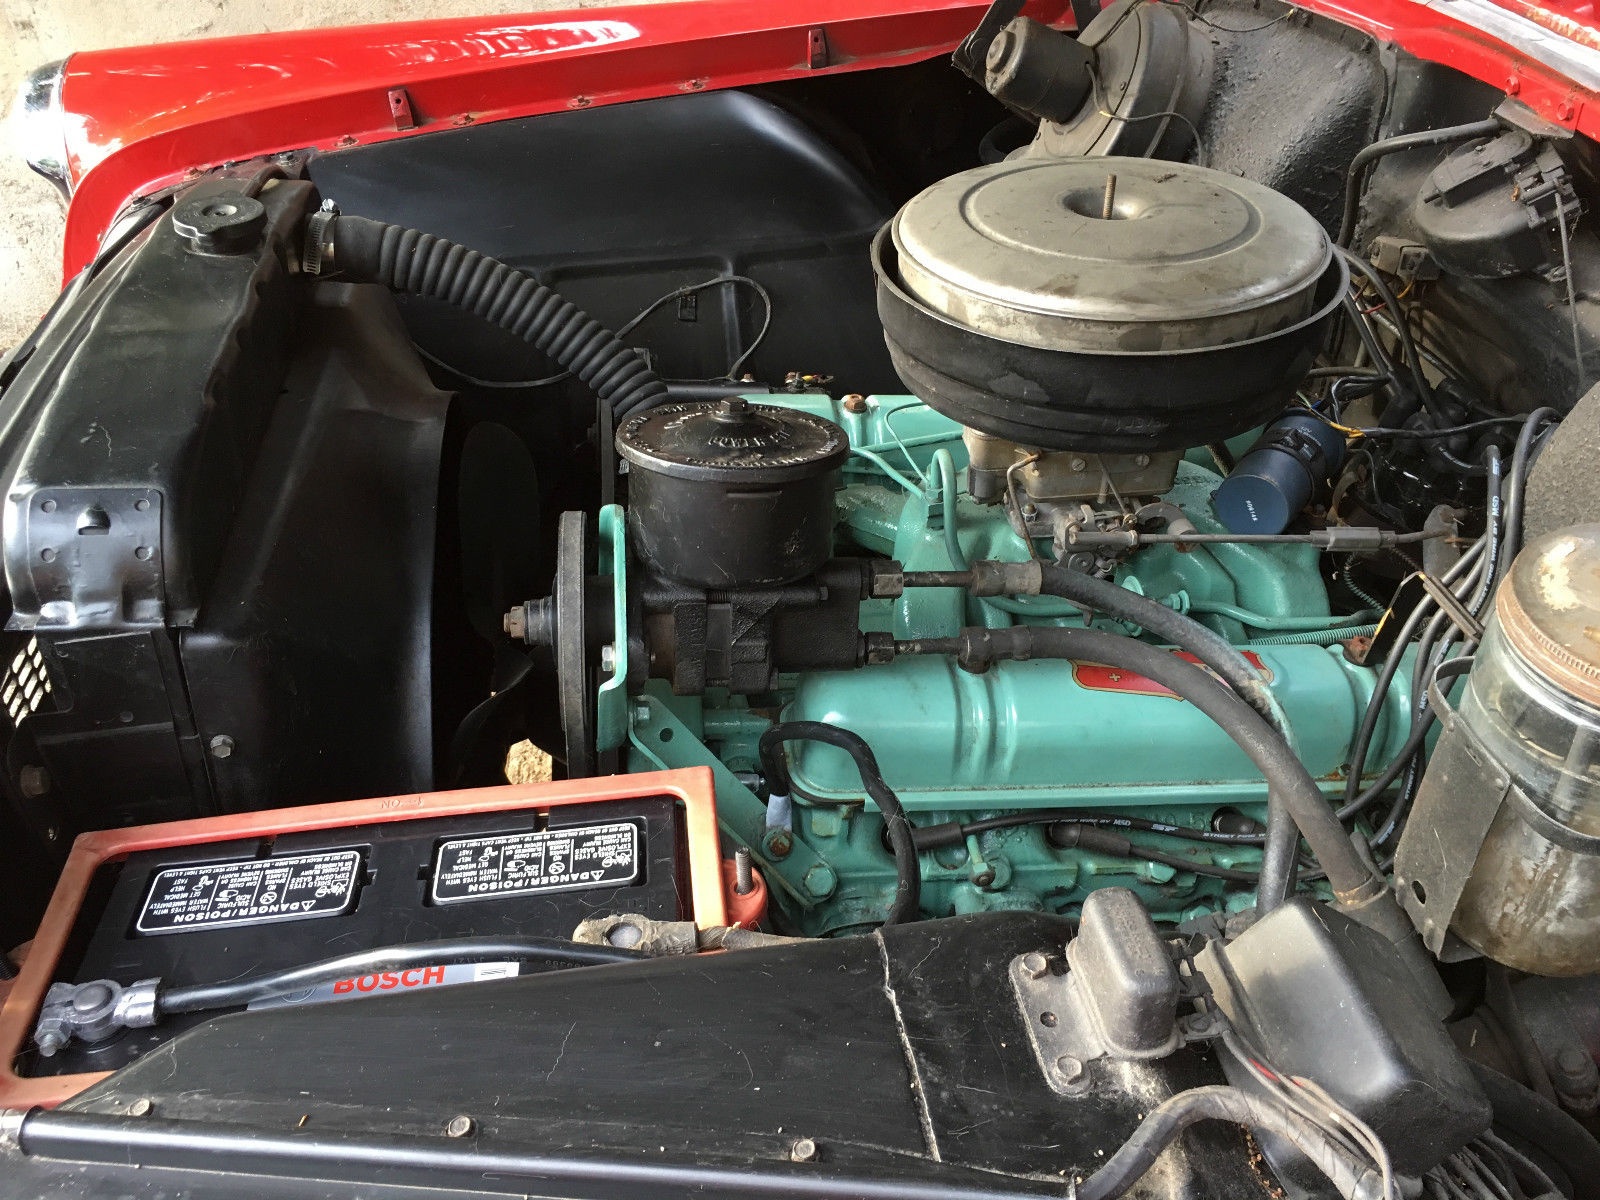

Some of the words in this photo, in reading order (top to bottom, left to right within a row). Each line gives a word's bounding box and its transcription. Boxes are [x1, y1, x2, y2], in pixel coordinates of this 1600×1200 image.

[1492, 520, 1498, 535] BY
[456, 855, 472, 863] HELP
[574, 852, 590, 860] EYES
[451, 862, 476, 871] MEDICAL
[289, 875, 313, 883] GASES
[314, 871, 350, 881] EXPLOSIVE
[478, 873, 497, 882] FLUSH
[172, 877, 189, 885] FAST
[288, 881, 307, 889] EYES
[445, 877, 461, 885] WITH
[467, 870, 589, 893] DANGER/POISON
[168, 884, 186, 892] HELP
[162, 892, 189, 900] MEDICAL
[187, 897, 209, 905] WATER
[215, 899, 250, 909] SULFURIC
[151, 907, 170, 915] WITH
[186, 903, 207, 912] FLUSH
[172, 901, 300, 923] DANGER/POISON
[333, 966, 445, 994] BOSCH
